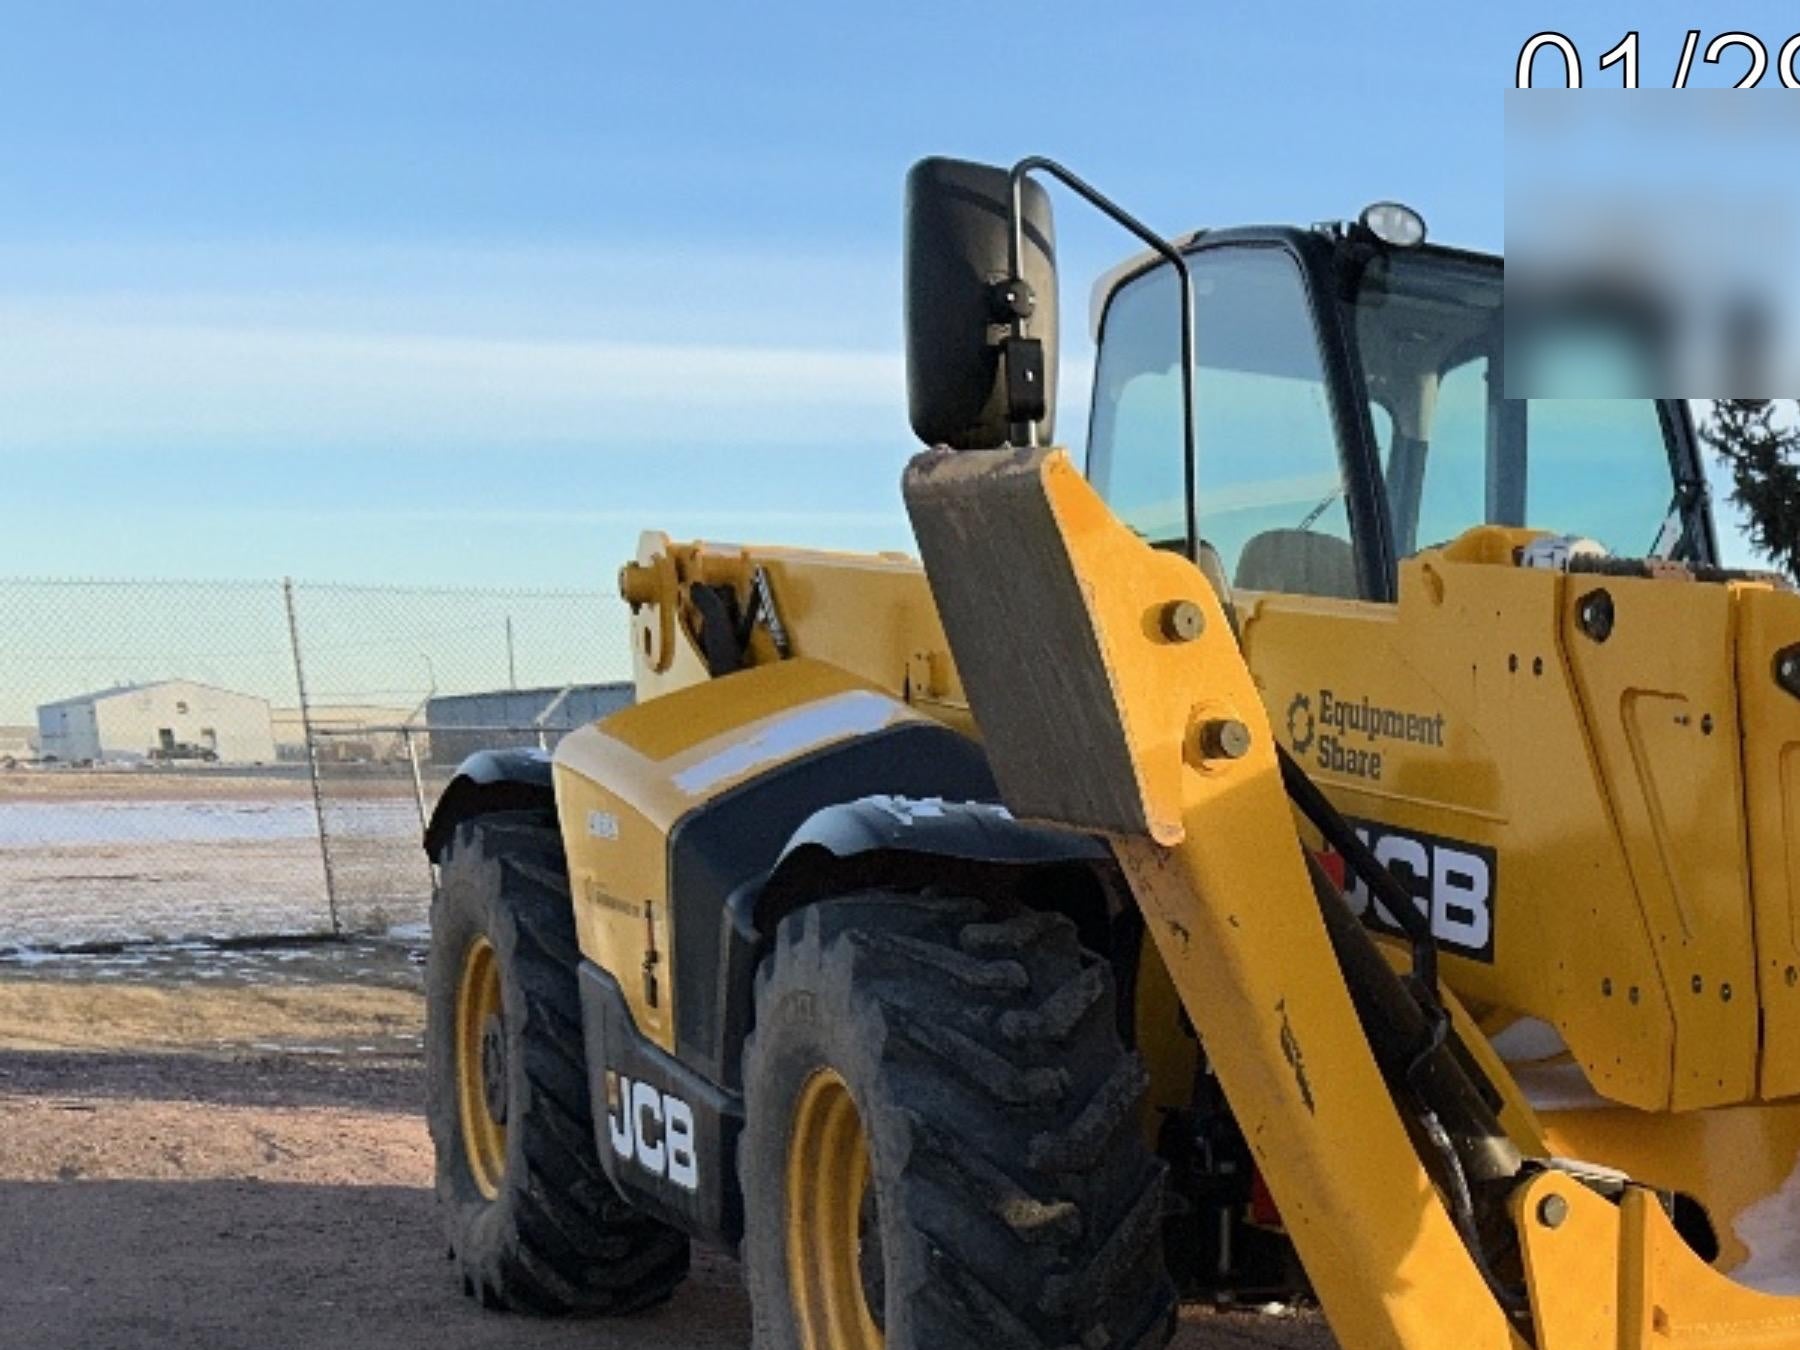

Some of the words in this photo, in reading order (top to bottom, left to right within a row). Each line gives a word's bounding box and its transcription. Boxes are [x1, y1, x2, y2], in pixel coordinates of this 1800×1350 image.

[1318, 689, 1446, 747] Equipment
[1316, 735, 1382, 781] Share
[607, 1076, 698, 1190] JCB
